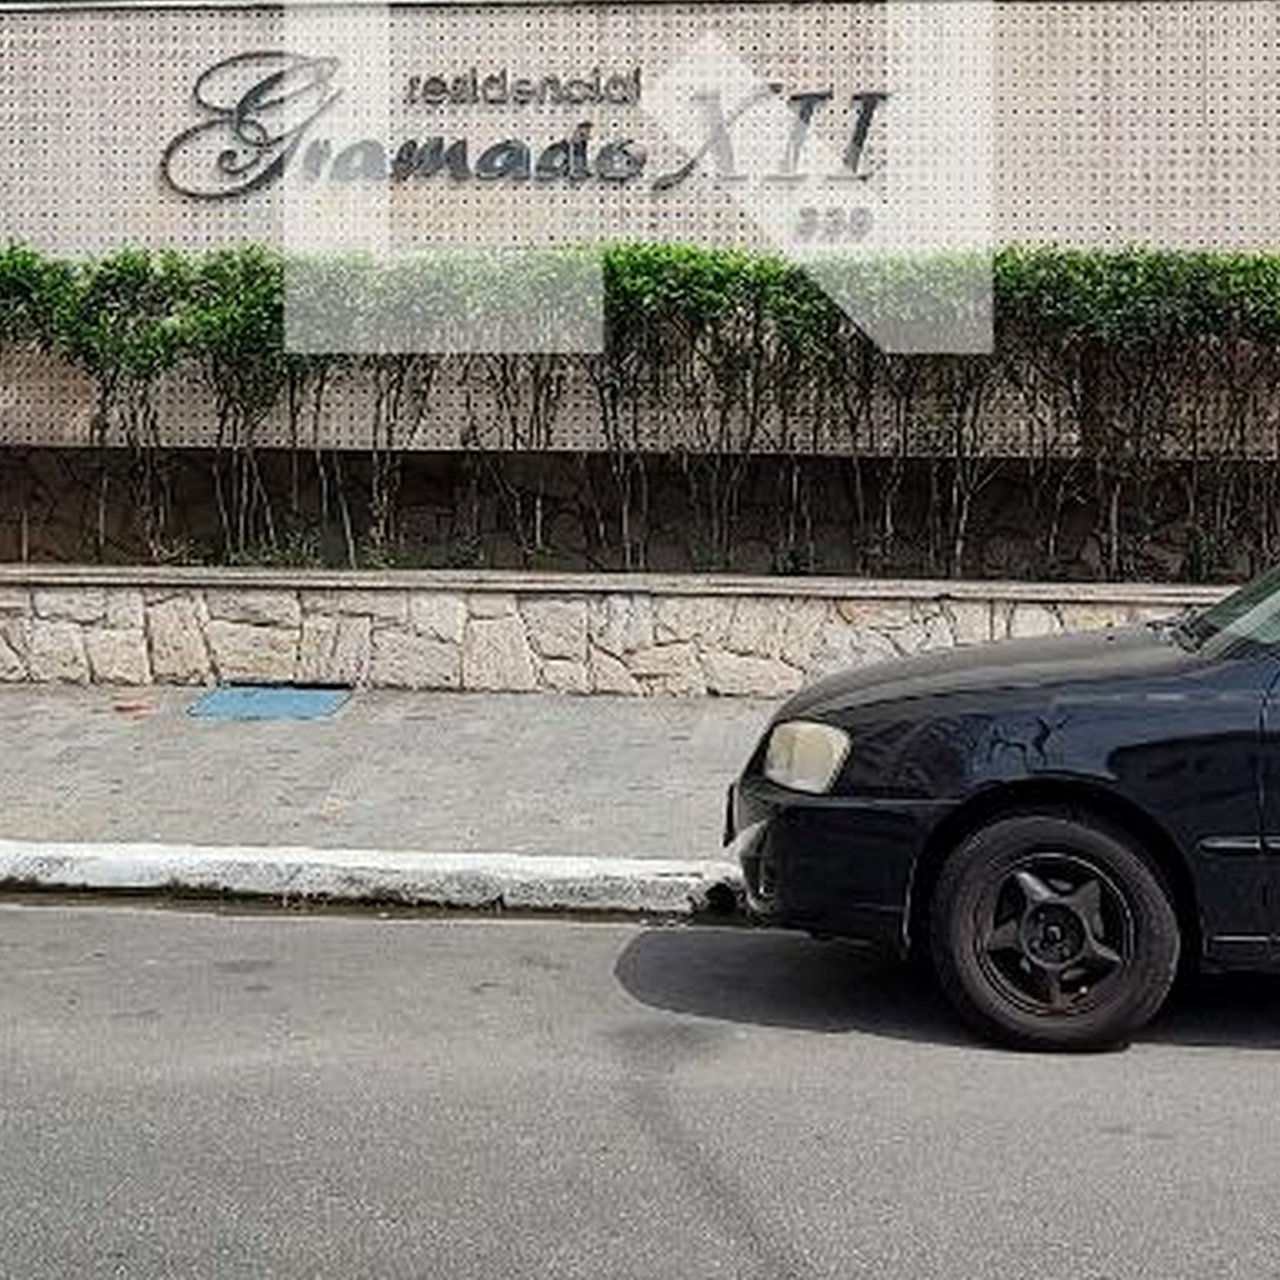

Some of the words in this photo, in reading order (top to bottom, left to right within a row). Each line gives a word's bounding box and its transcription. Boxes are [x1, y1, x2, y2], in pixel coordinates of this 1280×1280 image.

[158, 51, 647, 198] Gramado
[650, 83, 892, 193] XII
[408, 67, 641, 106] residencial
